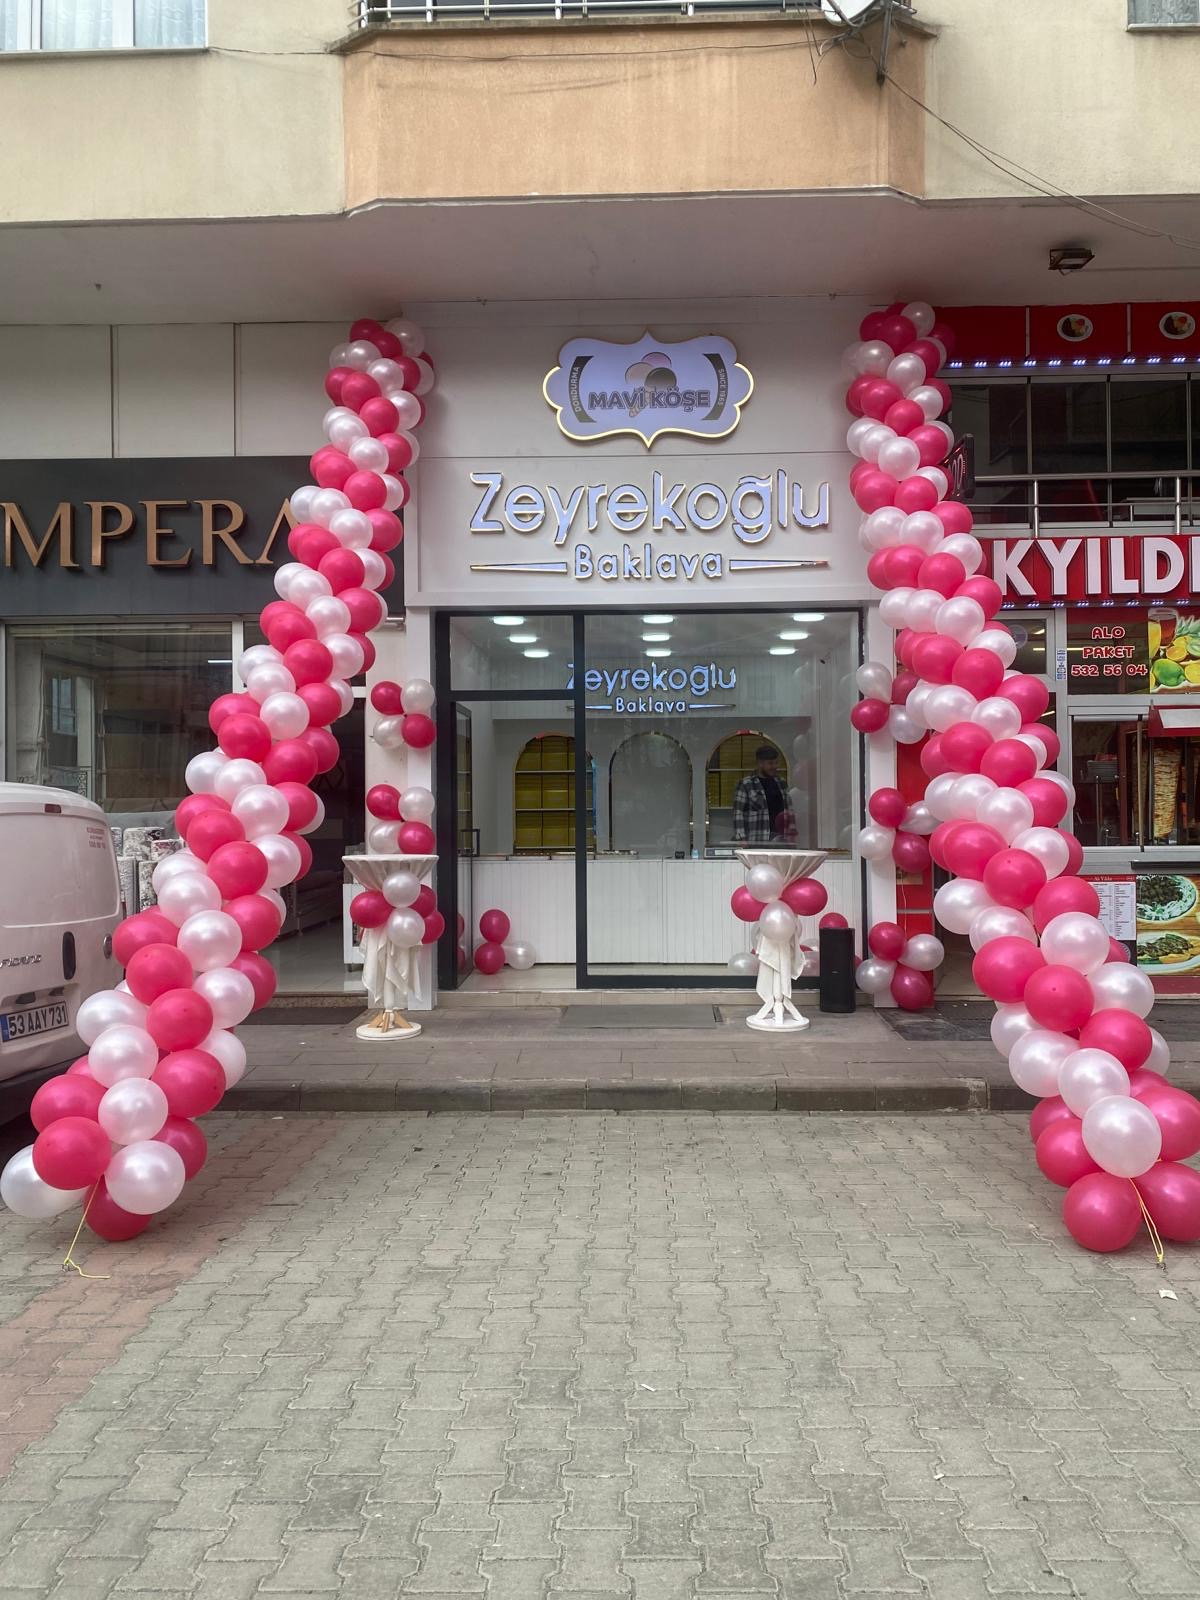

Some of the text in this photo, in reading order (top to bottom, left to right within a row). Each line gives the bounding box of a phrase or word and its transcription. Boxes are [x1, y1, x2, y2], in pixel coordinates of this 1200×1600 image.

[569, 366, 582, 412] DONDURMA
[717, 368, 728, 390] SINCE
[588, 385, 711, 413] MAVİ KÖŞE
[470, 468, 830, 545] Zeyrekoğlu
[574, 544, 723, 580] Baklava
[1091, 626, 1126, 640] ALO
[1082, 645, 1136, 659] PAKET
[1071, 664, 1099, 677] 532
[1103, 664, 1122, 677] 56
[1126, 663, 1148, 676] 04
[616, 697, 686, 713] Baklava
[8, 1005, 67, 1037] 53 AAY 731
